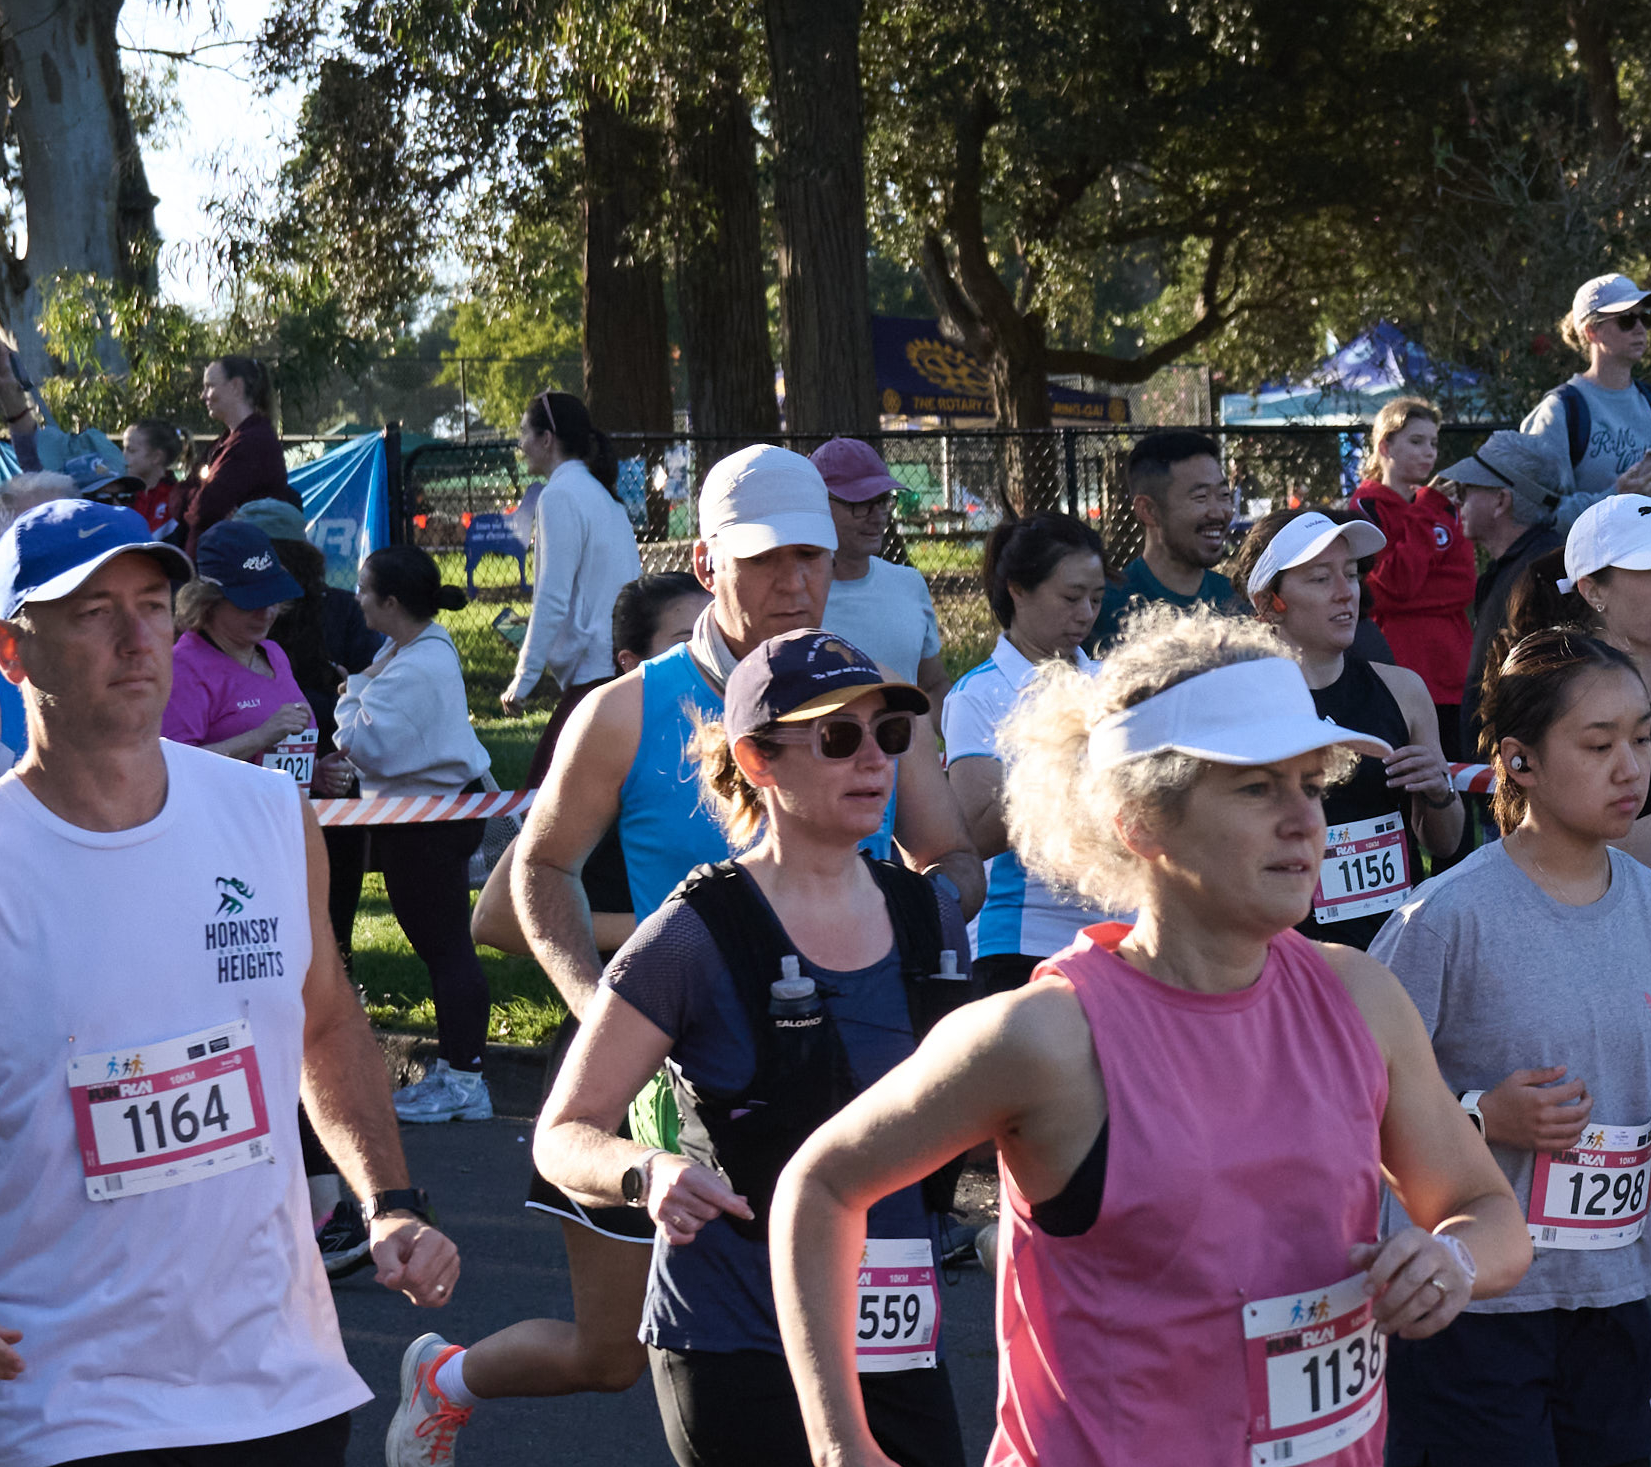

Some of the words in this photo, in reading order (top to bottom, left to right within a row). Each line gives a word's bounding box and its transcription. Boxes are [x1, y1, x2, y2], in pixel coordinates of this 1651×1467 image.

[937, 398, 982, 413] ROTARY
[236, 698, 261, 710] SALLY
[1338, 850, 1395, 893] 1156
[205, 916, 279, 951] HORNSBY
[217, 951, 284, 984] HEIGHTS
[775, 1016, 823, 1028] SALOMO
[169, 1070, 197, 1086] 10KM
[123, 1084, 230, 1153] 1164
[1569, 1169, 1646, 1216] 1298
[857, 1293, 921, 1340] 559
[1302, 1322, 1381, 1413] 1138
